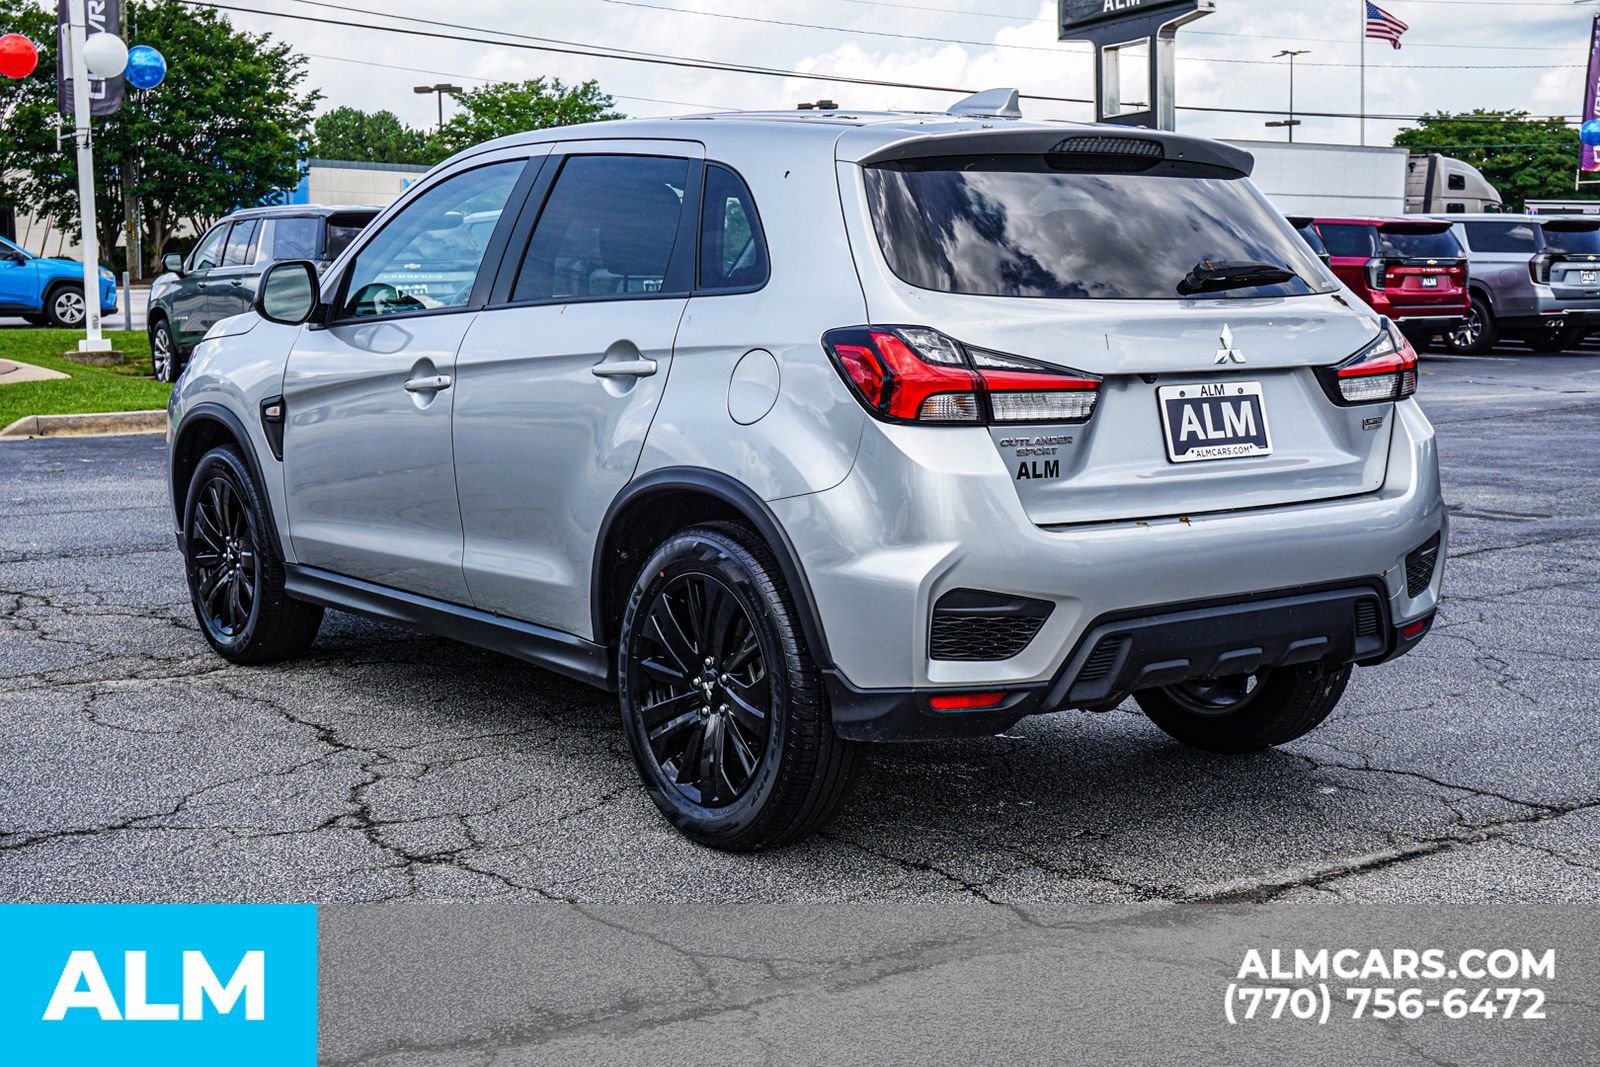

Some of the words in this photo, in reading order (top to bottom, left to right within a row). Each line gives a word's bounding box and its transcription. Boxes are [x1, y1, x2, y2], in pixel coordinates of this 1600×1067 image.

[1422, 278, 1438, 287] ALM
[1200, 384, 1225, 397] ALM
[1179, 400, 1257, 441] ALM
[1000, 435, 1073, 448] OUTLANDER
[1016, 447, 1058, 457] SPORT
[1196, 446, 1250, 458] ALMCARS.COM
[1016, 459, 1060, 480] ALM
